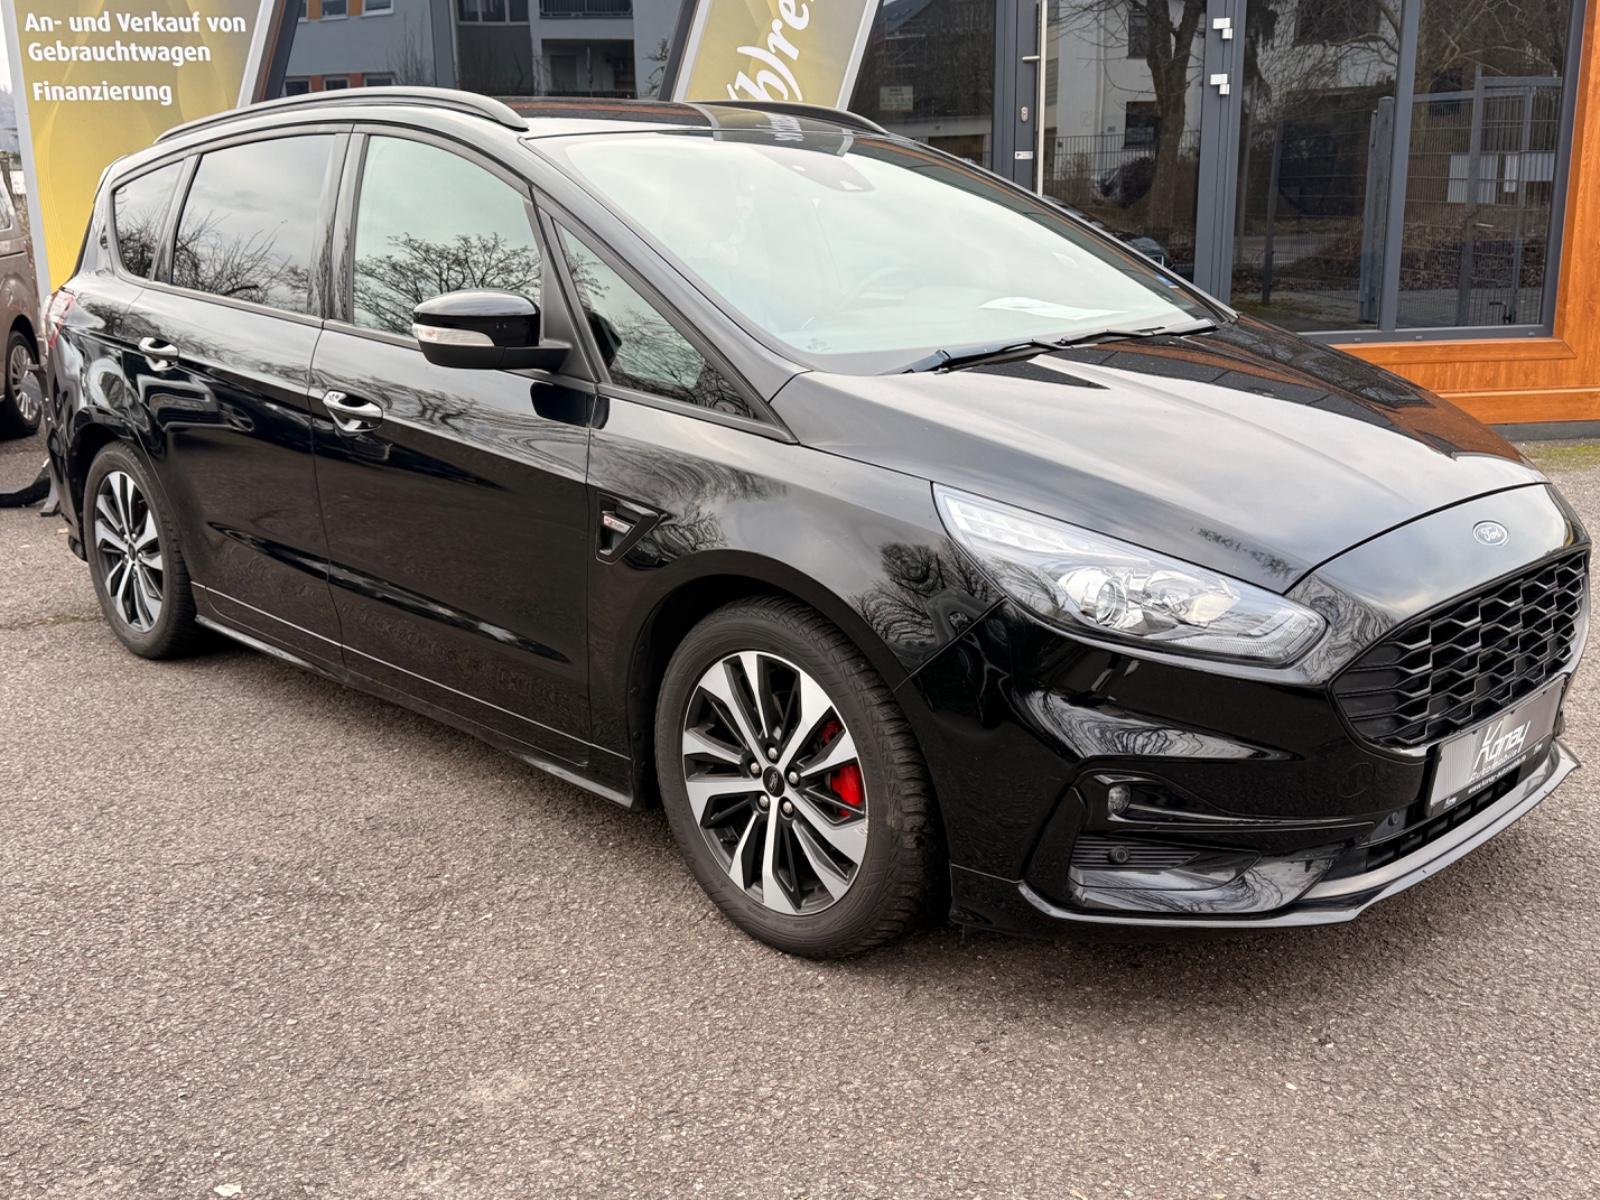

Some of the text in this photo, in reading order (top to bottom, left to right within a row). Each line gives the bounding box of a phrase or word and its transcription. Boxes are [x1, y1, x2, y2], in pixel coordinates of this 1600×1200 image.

[25, 11, 246, 32] An- und Verkauf von
[28, 41, 211, 67] Gebrauchtwagen
[32, 81, 172, 105] Finanzierung
